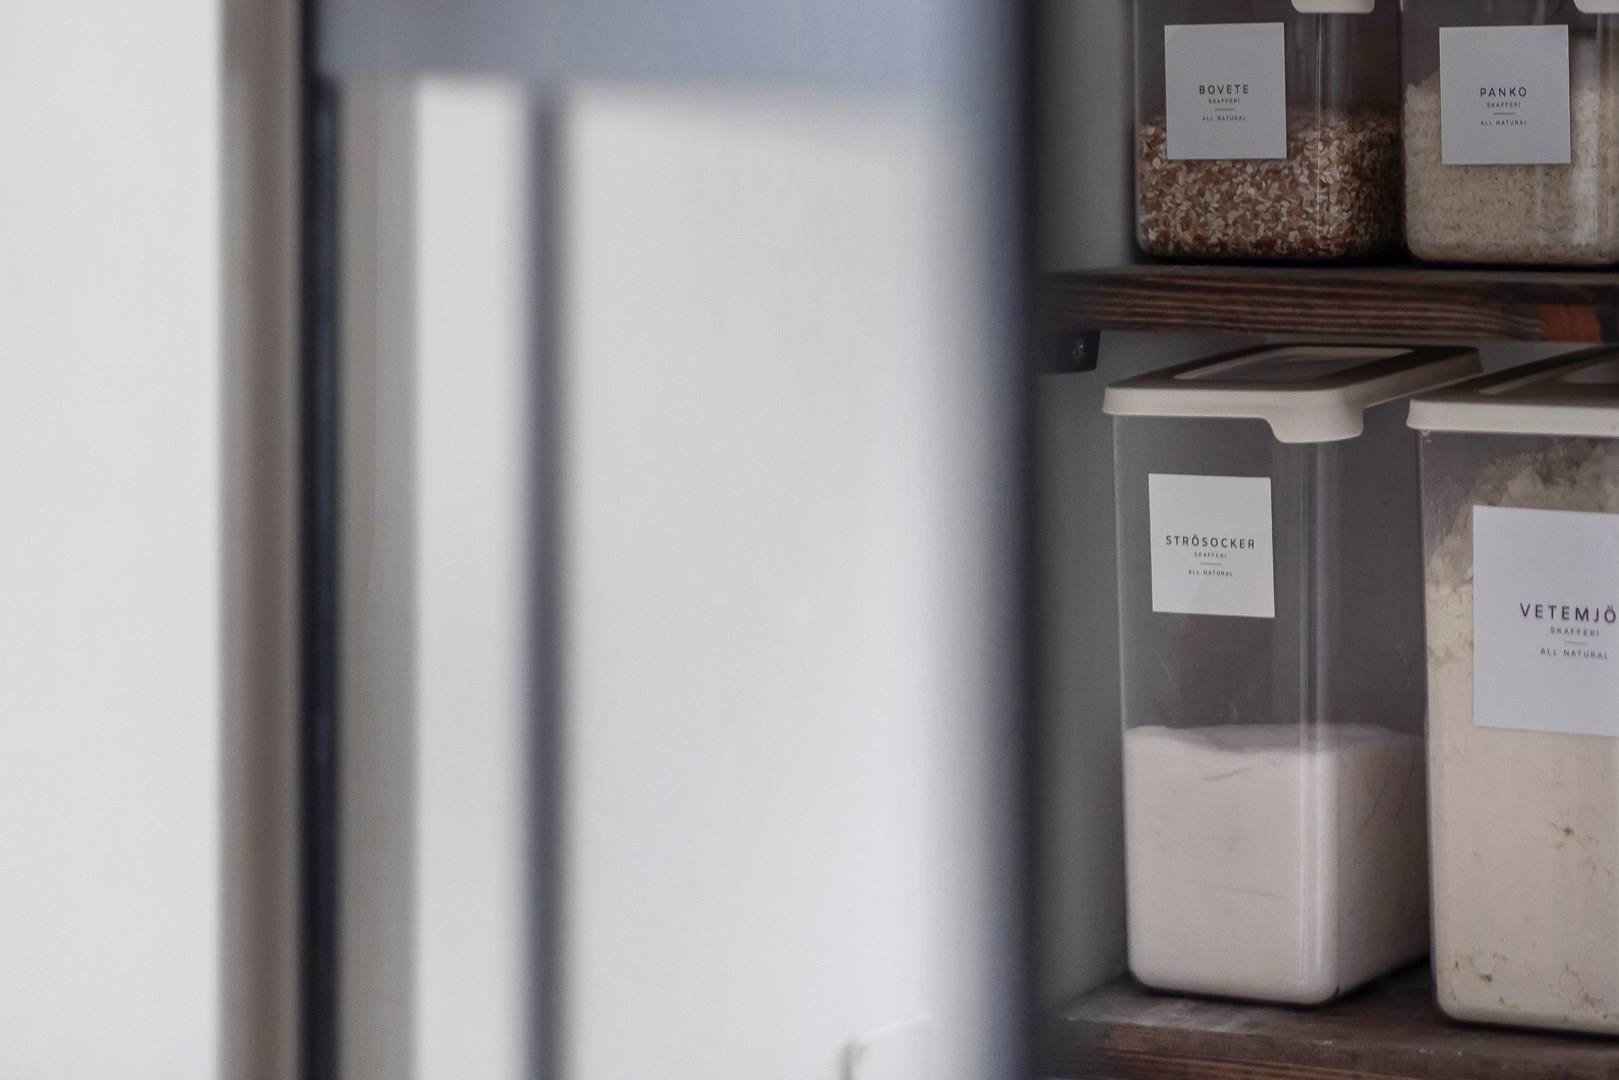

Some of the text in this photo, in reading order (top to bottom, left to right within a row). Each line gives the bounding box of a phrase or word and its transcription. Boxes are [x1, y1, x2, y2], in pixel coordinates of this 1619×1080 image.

[1199, 84, 1249, 95] BOVETE
[1480, 86, 1527, 98] PANKO
[1165, 534, 1255, 549] STRÖSOCKER
[1550, 626, 1600, 637] SKAFFERI
[1540, 647, 1609, 660] ALL NATURAL
